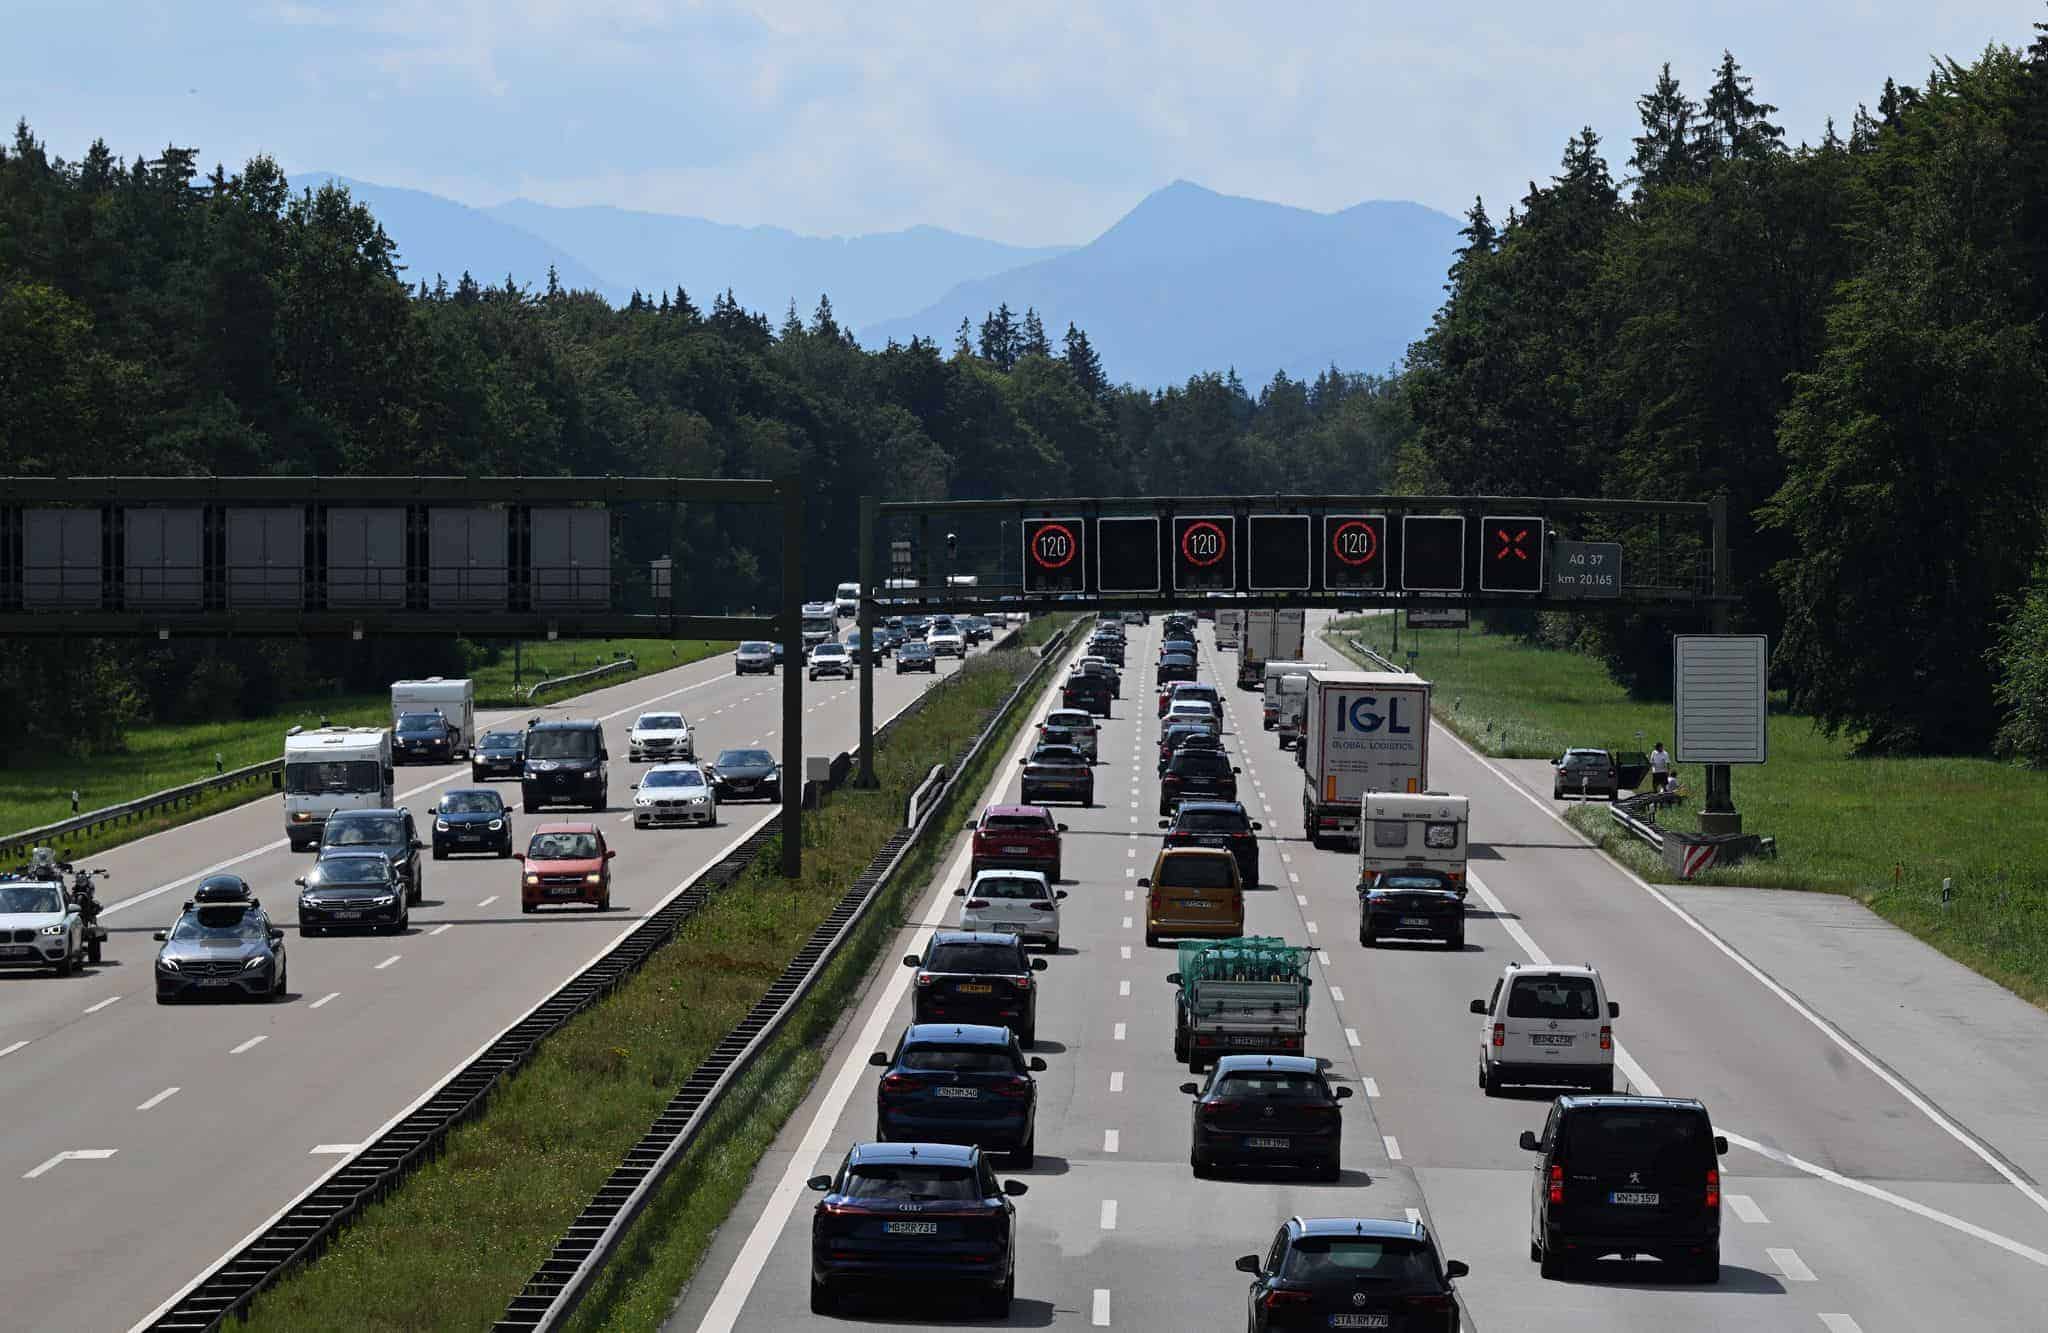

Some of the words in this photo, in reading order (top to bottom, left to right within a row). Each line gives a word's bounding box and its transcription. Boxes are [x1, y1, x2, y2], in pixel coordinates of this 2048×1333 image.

[1040, 536, 1066, 557] 120
[1191, 534, 1217, 554] 120
[1342, 532, 1367, 554] 120
[1569, 554, 1585, 565] AQ
[1590, 554, 1603, 565] 37
[1558, 574, 1575, 585] km
[1580, 575, 1612, 585] 20.165
[1336, 695, 1410, 733] IGL
